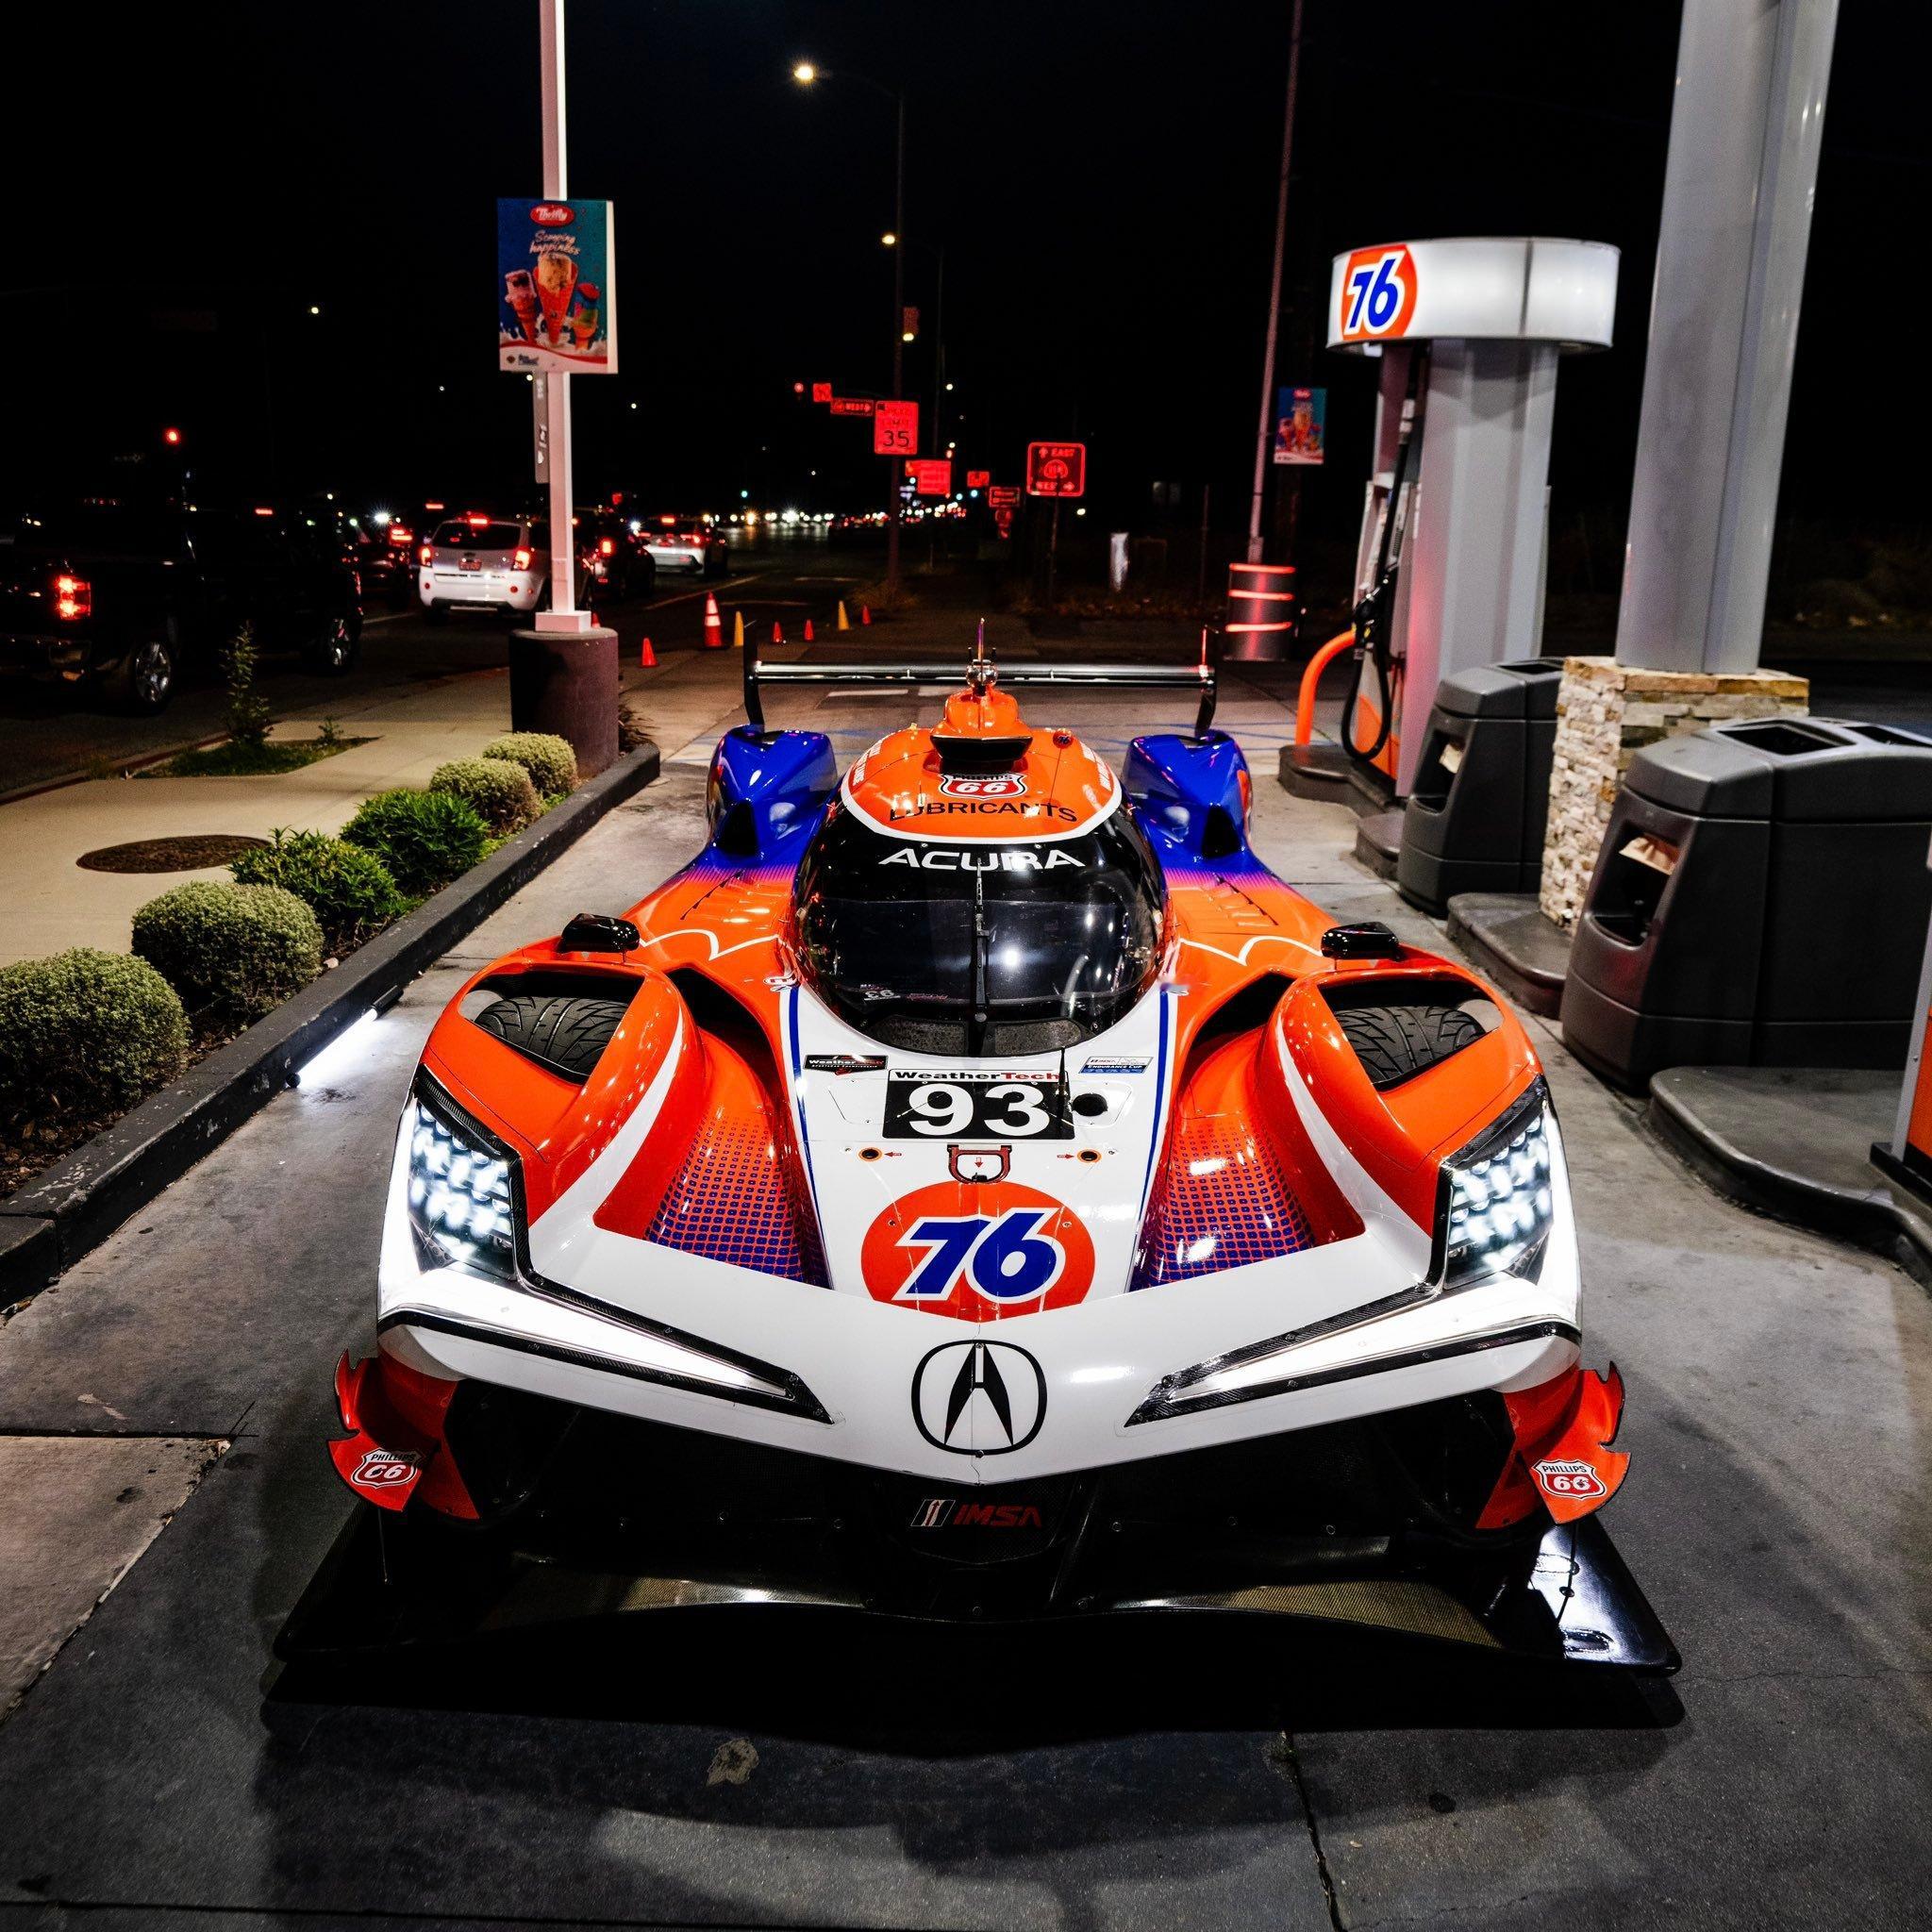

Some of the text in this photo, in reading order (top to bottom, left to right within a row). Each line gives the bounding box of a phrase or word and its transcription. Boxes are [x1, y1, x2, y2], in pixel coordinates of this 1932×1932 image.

[1345, 249, 1406, 335] 76
[882, 429, 910, 448] 35
[956, 781, 1009, 793] 66
[890, 802, 1077, 823] LUBRICANTS
[878, 847, 1086, 872] ACURA
[895, 1071, 1059, 1080] WeatherTech
[908, 1083, 1050, 1136] 93
[892, 1208, 1066, 1305] 76
[371, 1453, 416, 1462] PHILLIPS
[1553, 1475, 1591, 1491] 66
[953, 1504, 1041, 1527] IMSA
